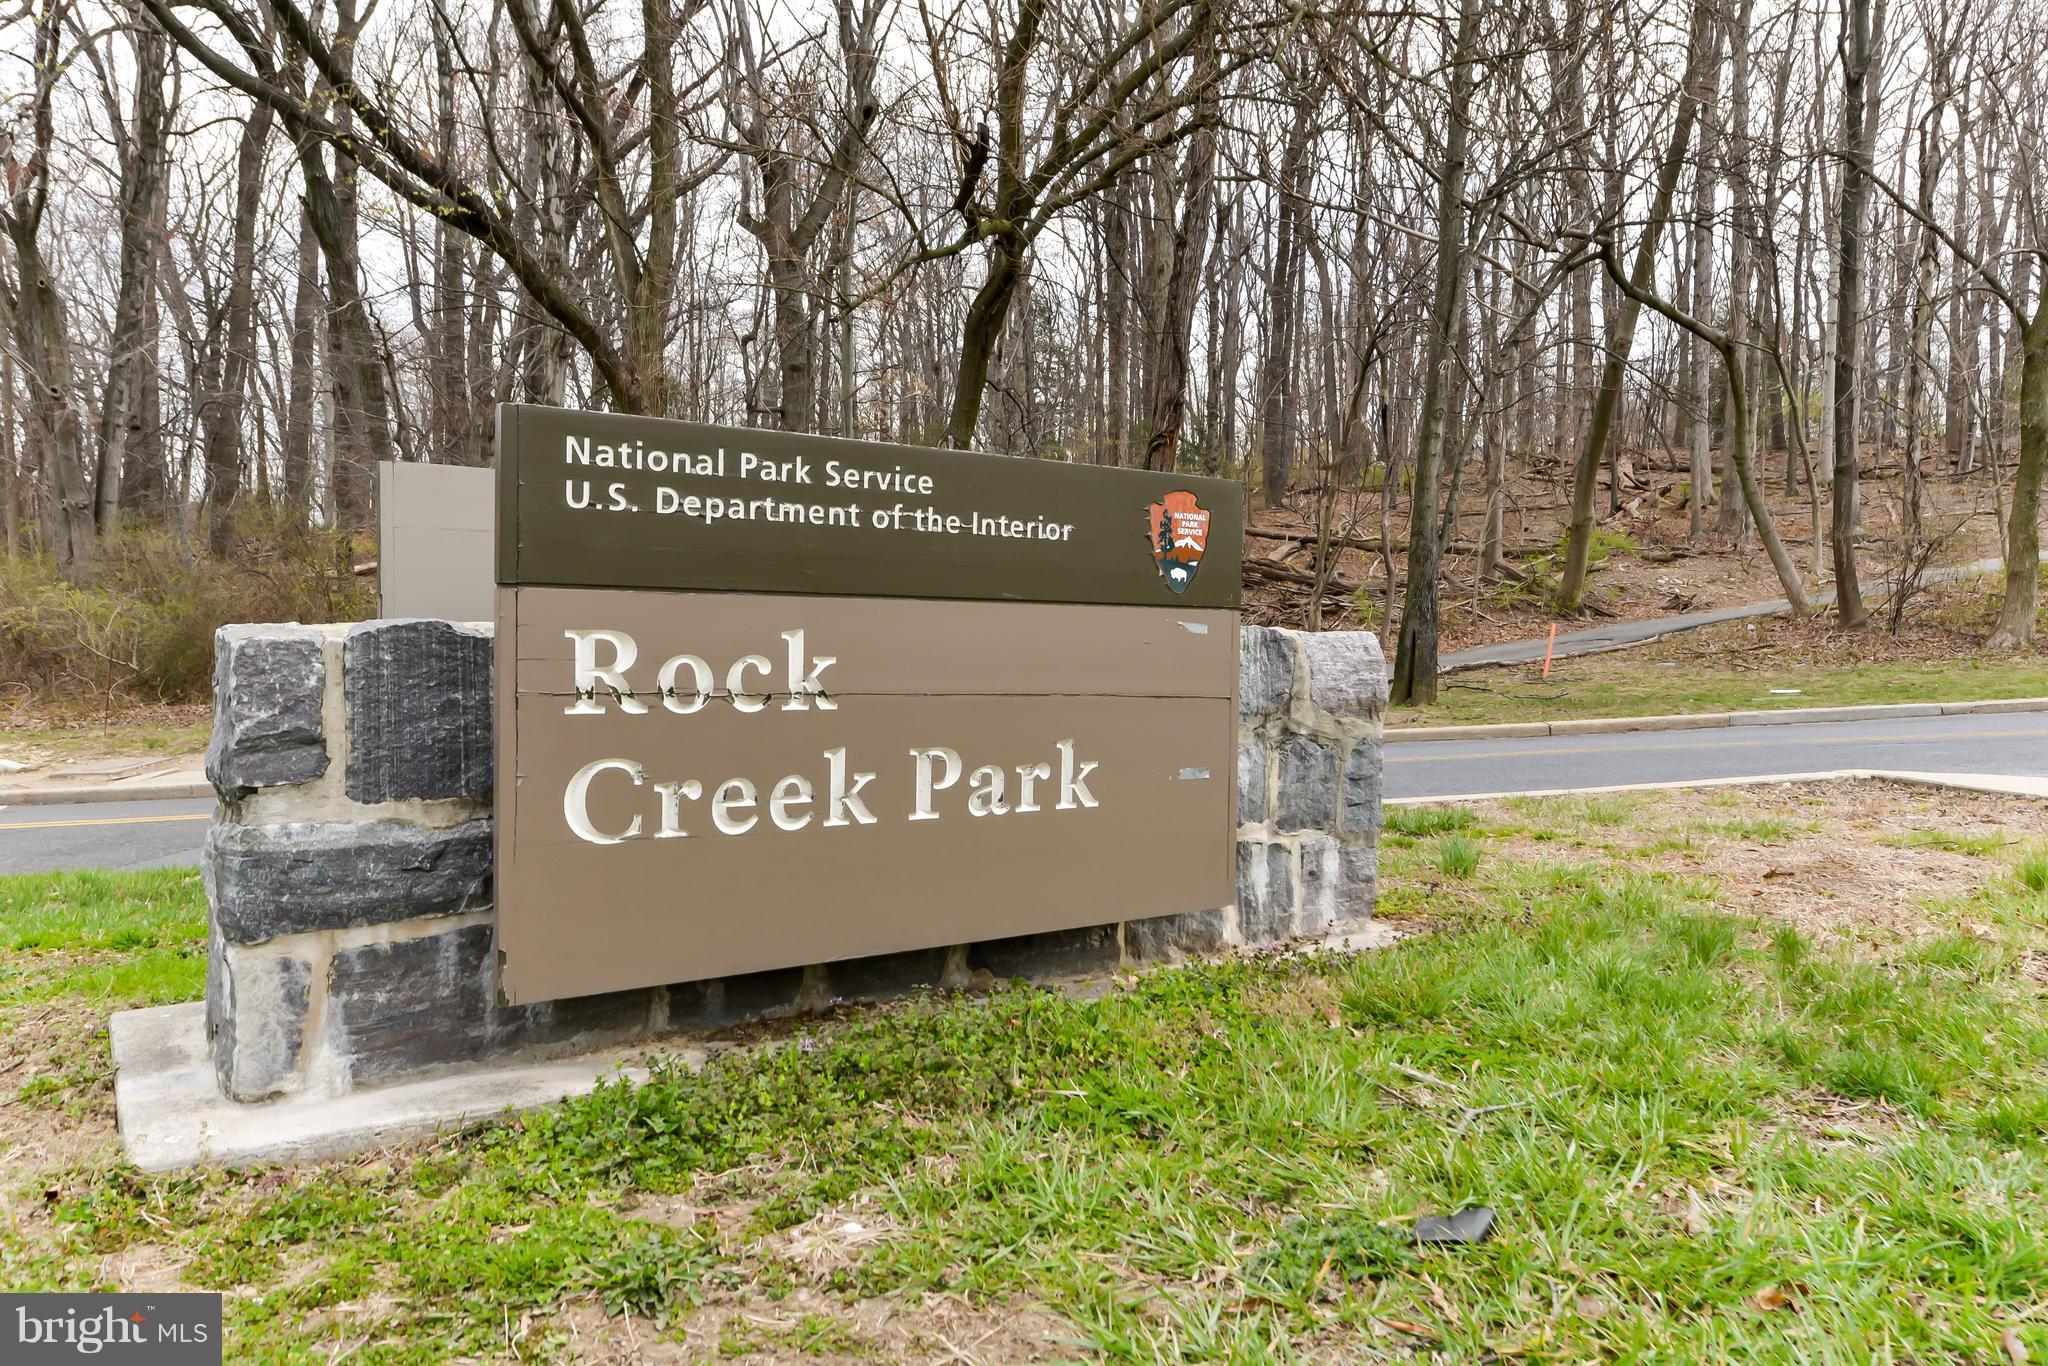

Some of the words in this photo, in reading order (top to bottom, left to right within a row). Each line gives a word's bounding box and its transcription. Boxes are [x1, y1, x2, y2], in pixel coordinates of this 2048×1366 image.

[565, 436, 725, 476] National
[740, 452, 811, 484] Park
[826, 461, 934, 495] Service
[565, 481, 639, 512] U.S.
[656, 486, 861, 527] Department
[872, 504, 904, 530] of
[914, 506, 960, 534] the
[973, 511, 1073, 541] Interior
[1174, 512, 1206, 521] NATIONAL
[1177, 528, 1203, 536] SERVICE
[564, 628, 838, 715] Rock
[563, 746, 878, 845] Creek
[908, 738, 1099, 820] Park
